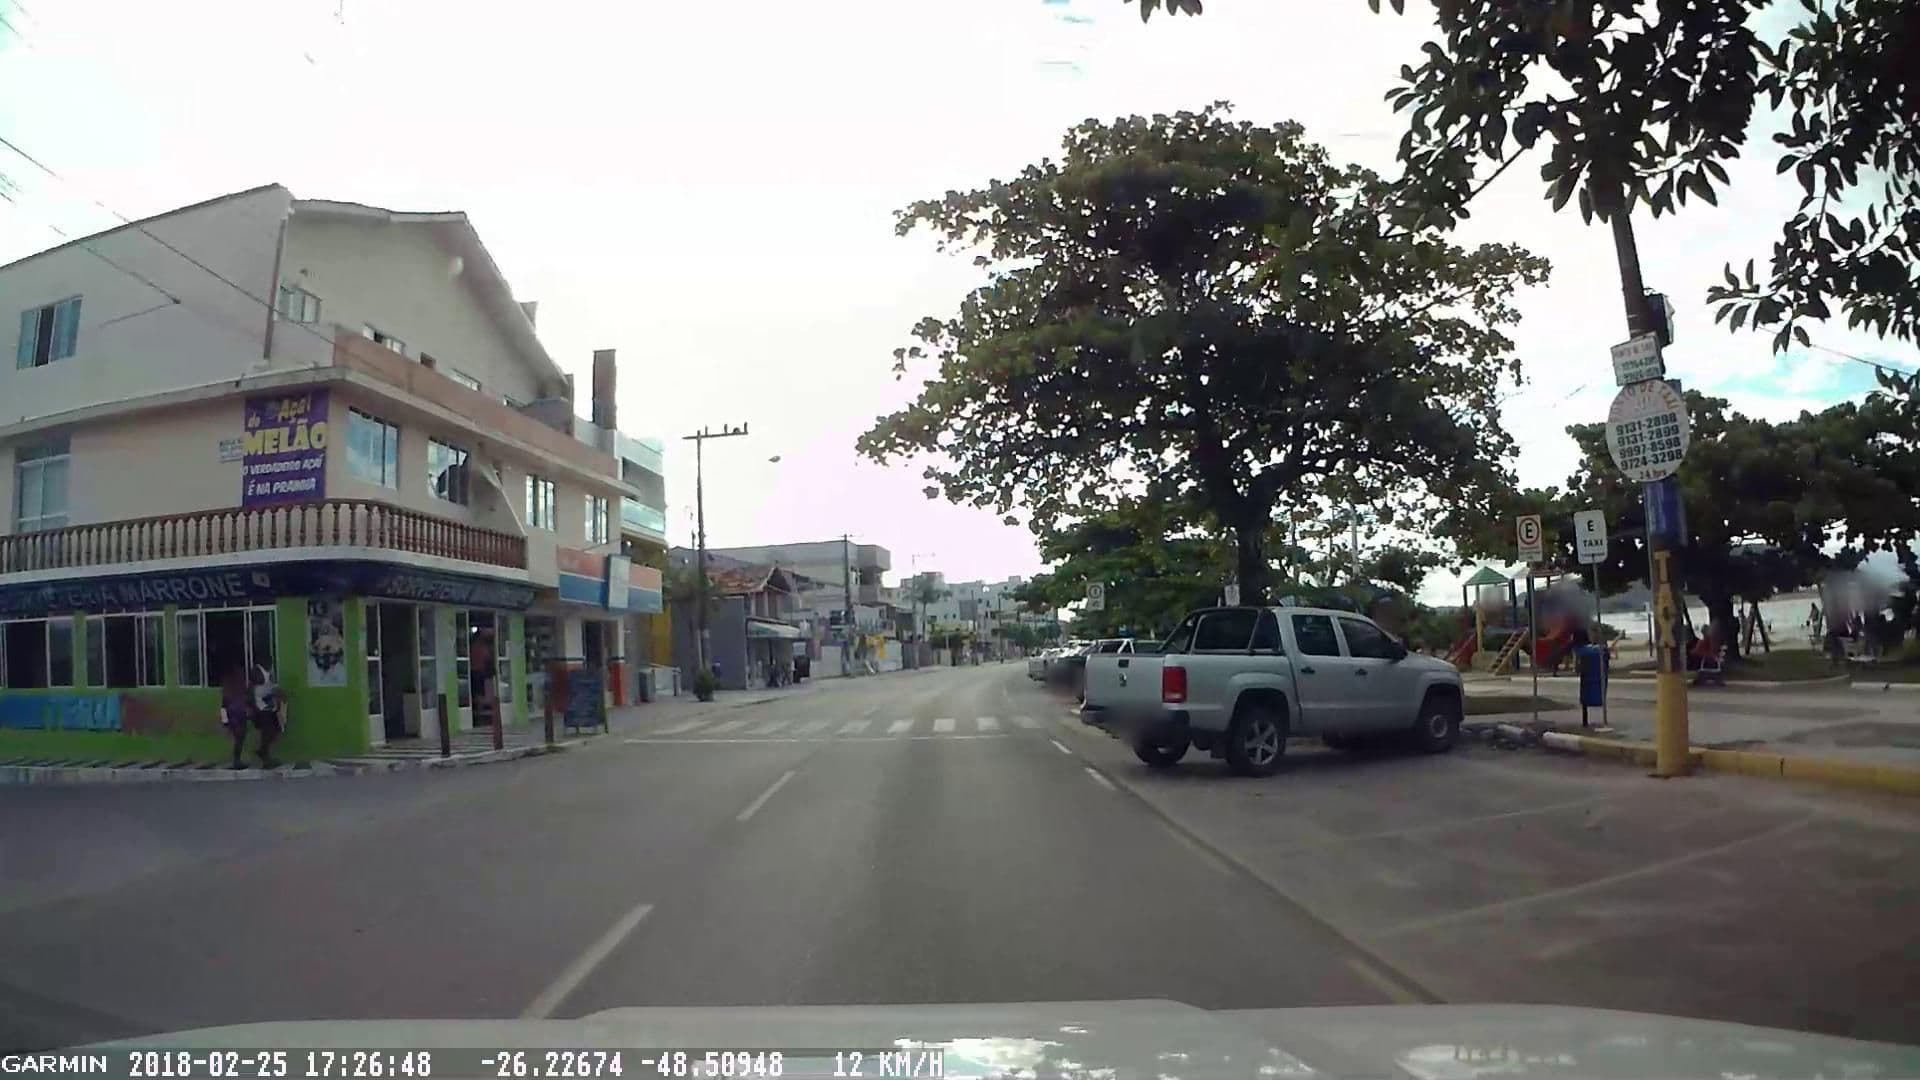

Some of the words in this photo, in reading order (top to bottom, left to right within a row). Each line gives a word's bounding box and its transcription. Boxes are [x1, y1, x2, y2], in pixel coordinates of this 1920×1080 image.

[1616, 412, 1678, 436] 9131-2898
[1617, 424, 1680, 447] 9131-2899
[244, 419, 328, 456] MELÃO
[1621, 448, 1683, 471] 9724-3298
[248, 479, 256, 496] É
[256, 482, 270, 496] NA
[1525, 522, 1533, 539] E
[1587, 519, 1595, 532] E
[1583, 539, 1603, 548] TAXI
[119, 573, 246, 602] MARRONE
